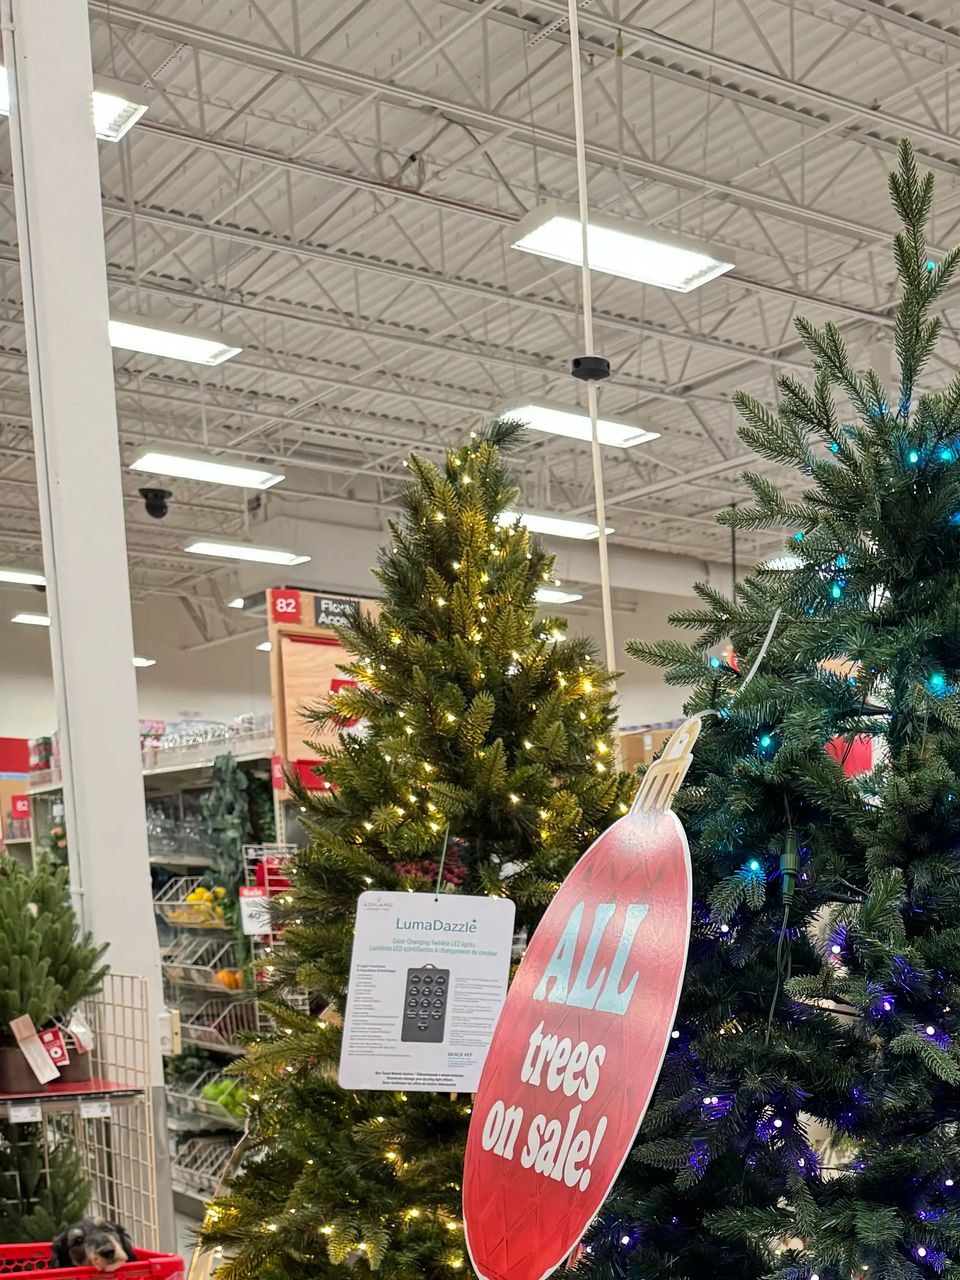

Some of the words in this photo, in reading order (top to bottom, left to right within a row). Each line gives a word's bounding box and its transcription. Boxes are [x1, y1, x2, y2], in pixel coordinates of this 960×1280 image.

[276, 598, 297, 613] 82
[396, 917, 477, 934] LumaDazzle
[533, 901, 649, 1016] ALL
[520, 1020, 606, 1102] trees
[482, 1099, 523, 1160] on
[523, 1104, 608, 1193] sale!
